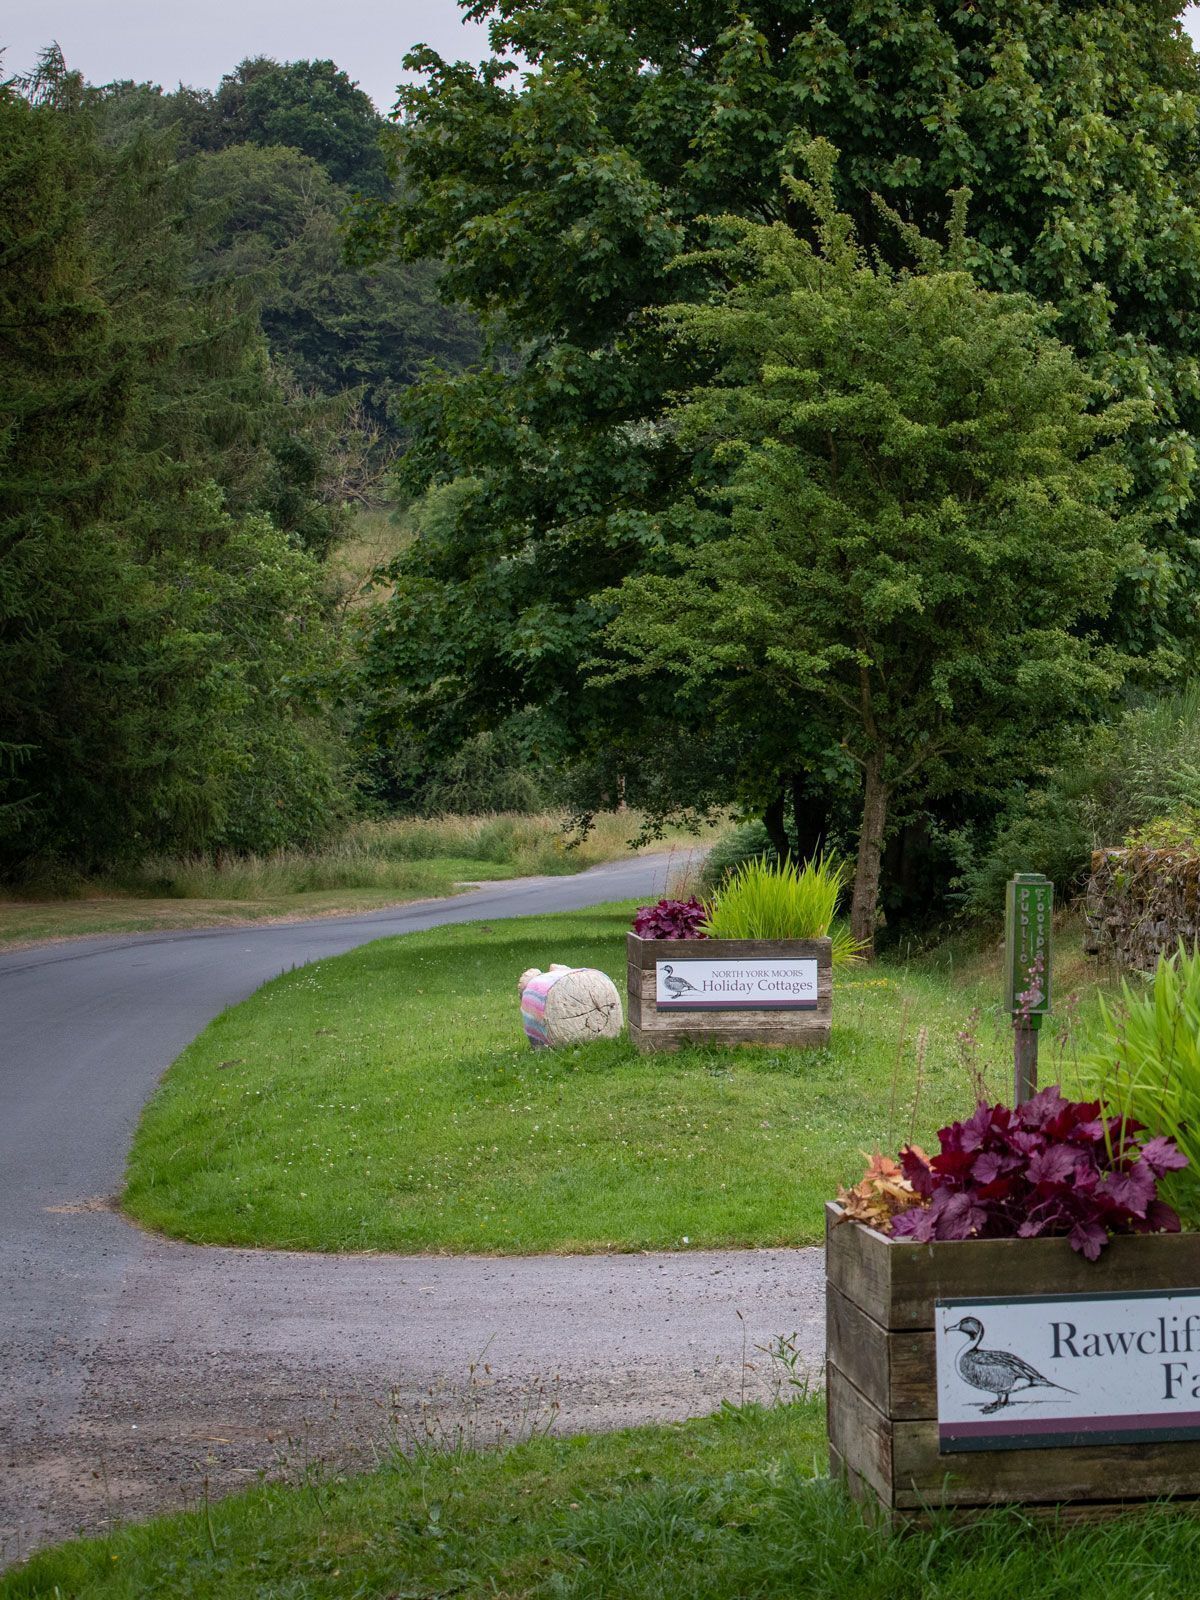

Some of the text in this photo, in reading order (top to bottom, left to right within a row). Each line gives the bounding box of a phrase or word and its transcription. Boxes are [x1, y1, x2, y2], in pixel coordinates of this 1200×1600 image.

[1020, 888, 1029, 963] Public
[712, 969, 804, 978] NORTH YORK MOORS
[703, 979, 813, 994] Holiday Cottages
